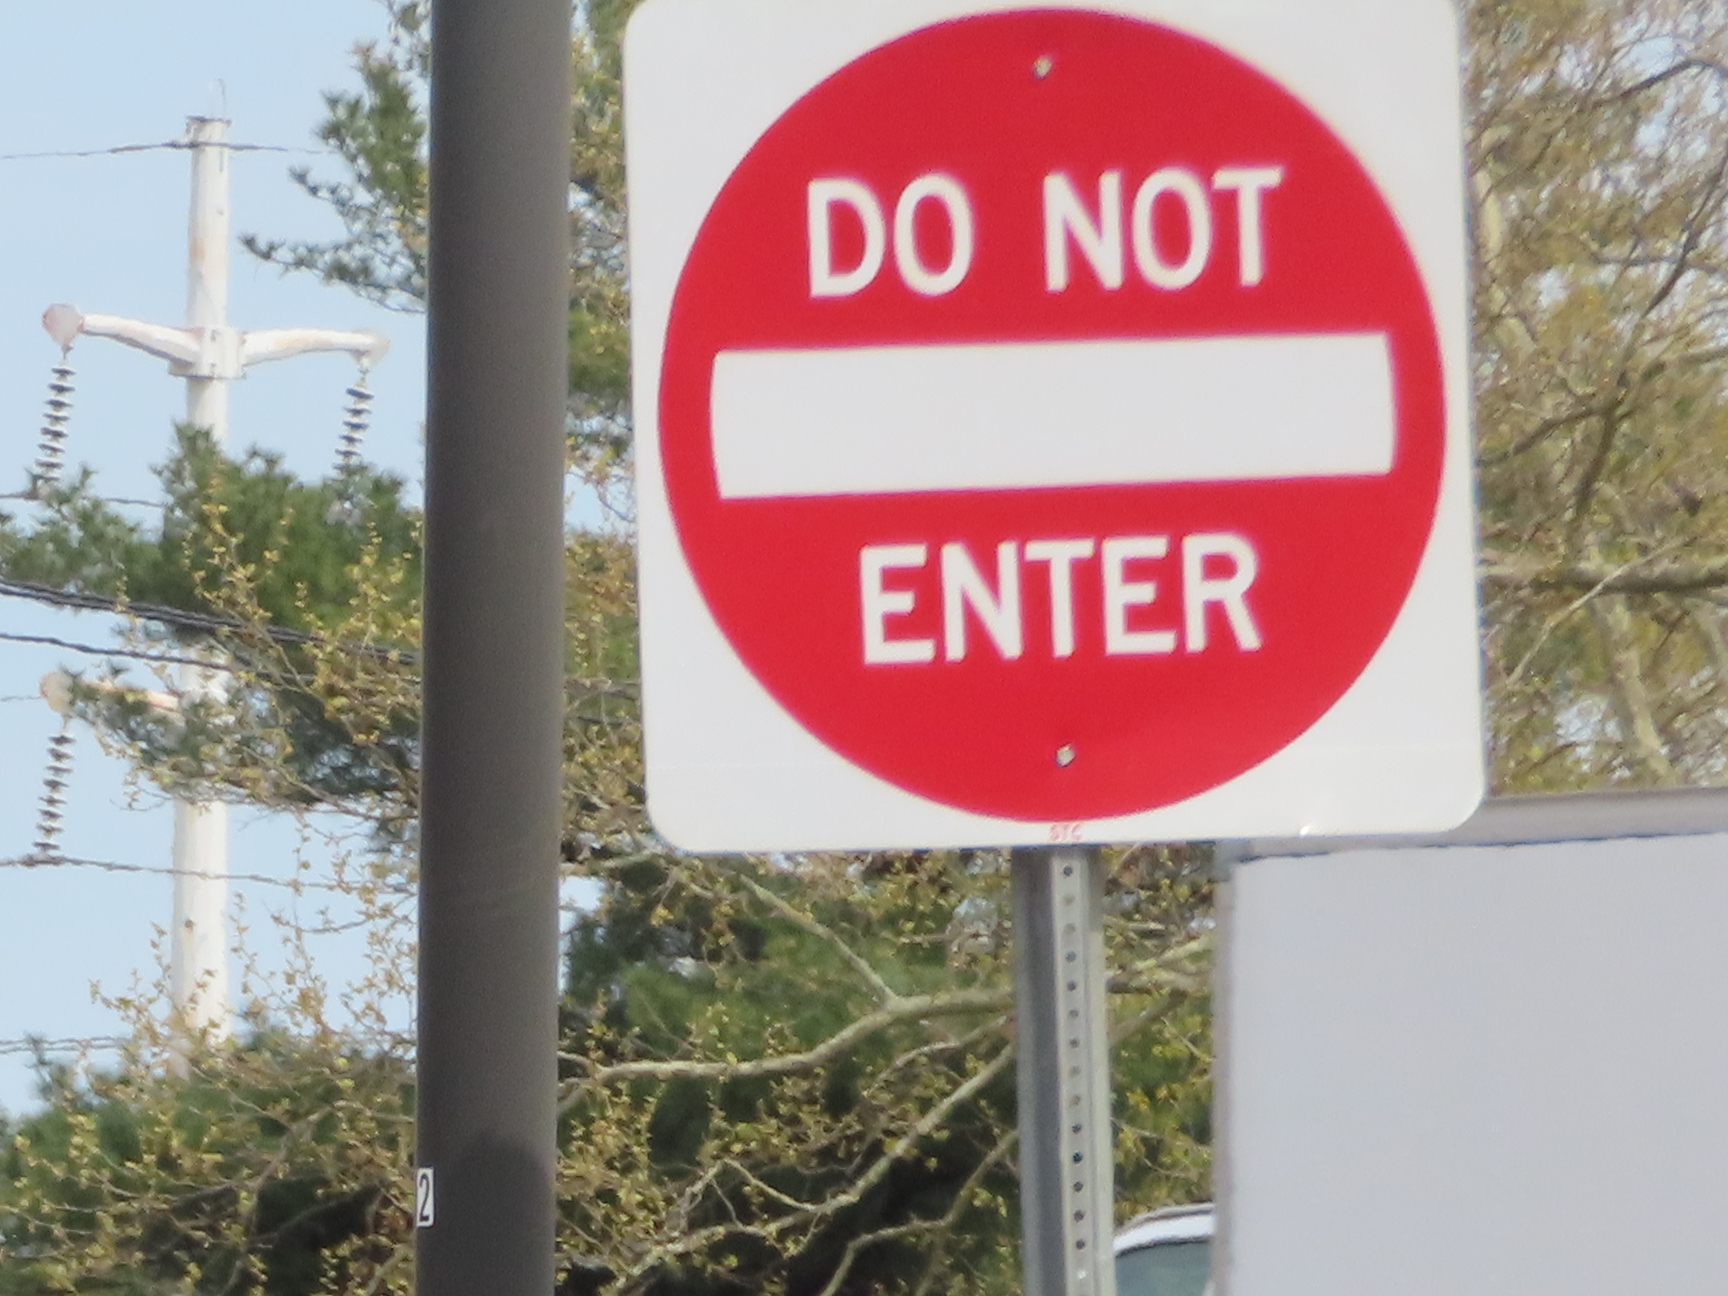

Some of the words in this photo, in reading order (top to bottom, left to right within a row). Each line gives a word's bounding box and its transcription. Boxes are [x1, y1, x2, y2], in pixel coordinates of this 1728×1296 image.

[807, 172, 974, 299] DO
[1042, 166, 1285, 294] NOT
[858, 532, 1265, 667] ENTER
